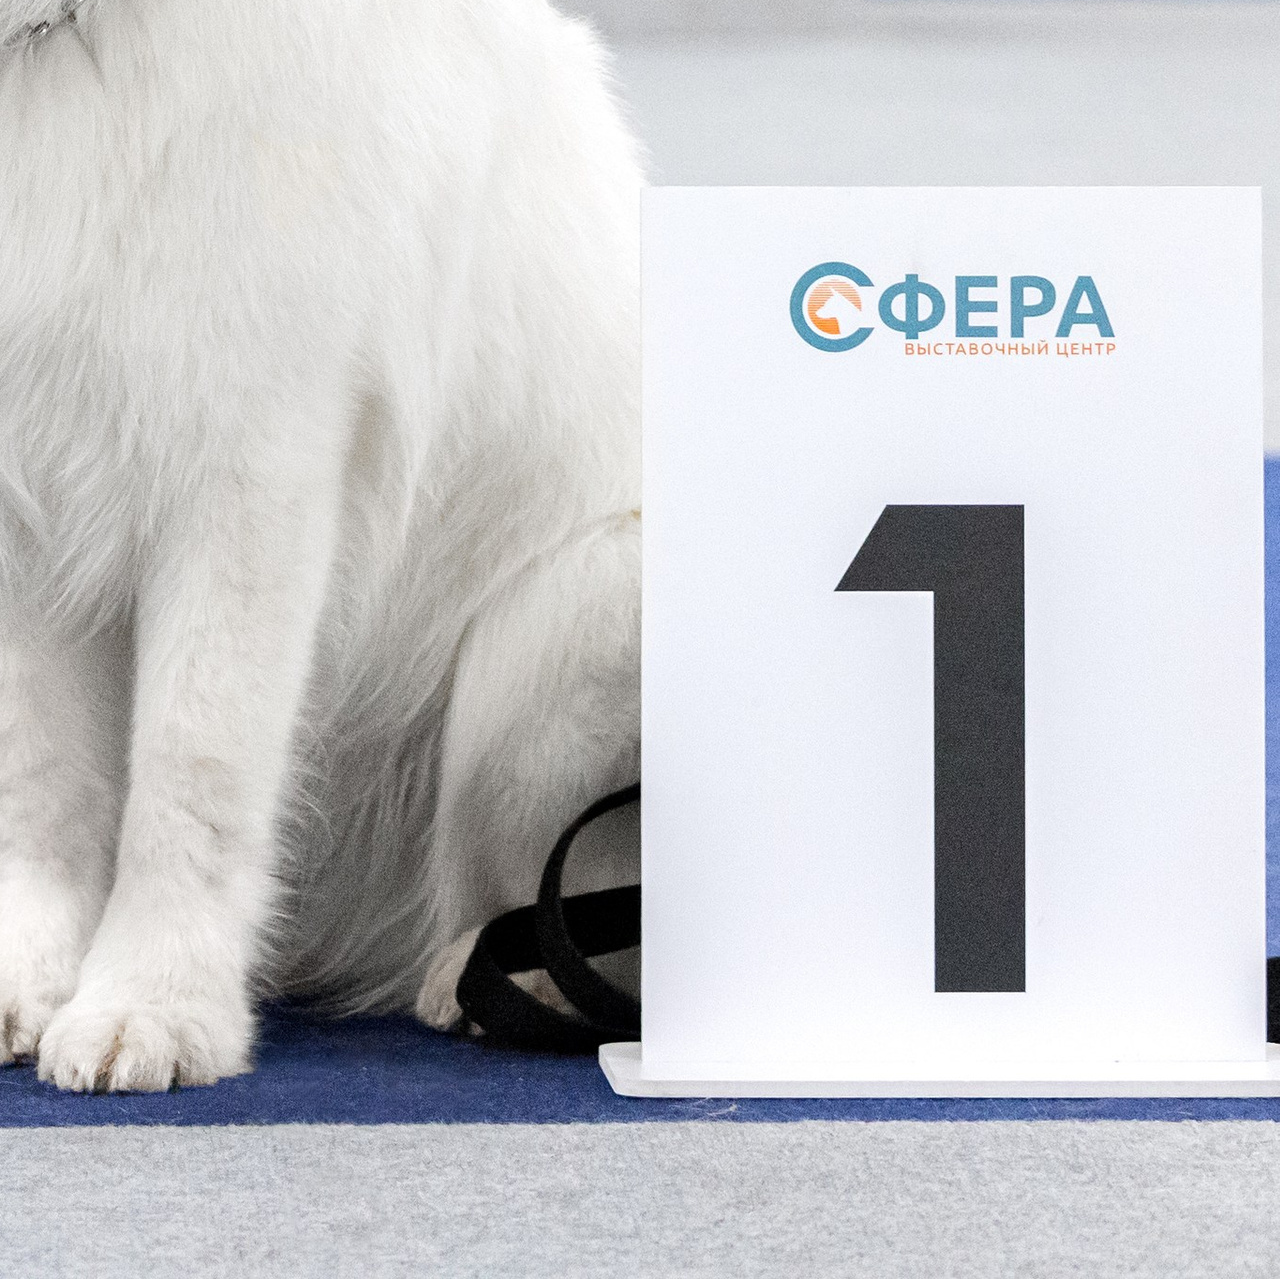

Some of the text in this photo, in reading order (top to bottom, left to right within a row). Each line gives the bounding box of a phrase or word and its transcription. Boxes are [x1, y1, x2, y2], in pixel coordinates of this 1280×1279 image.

[789, 261, 1116, 353] СФЕРА
[904, 340, 1117, 358] ВЫСТАВОЧНЫЙ ЦЕНТР
[834, 504, 1026, 993] 1
